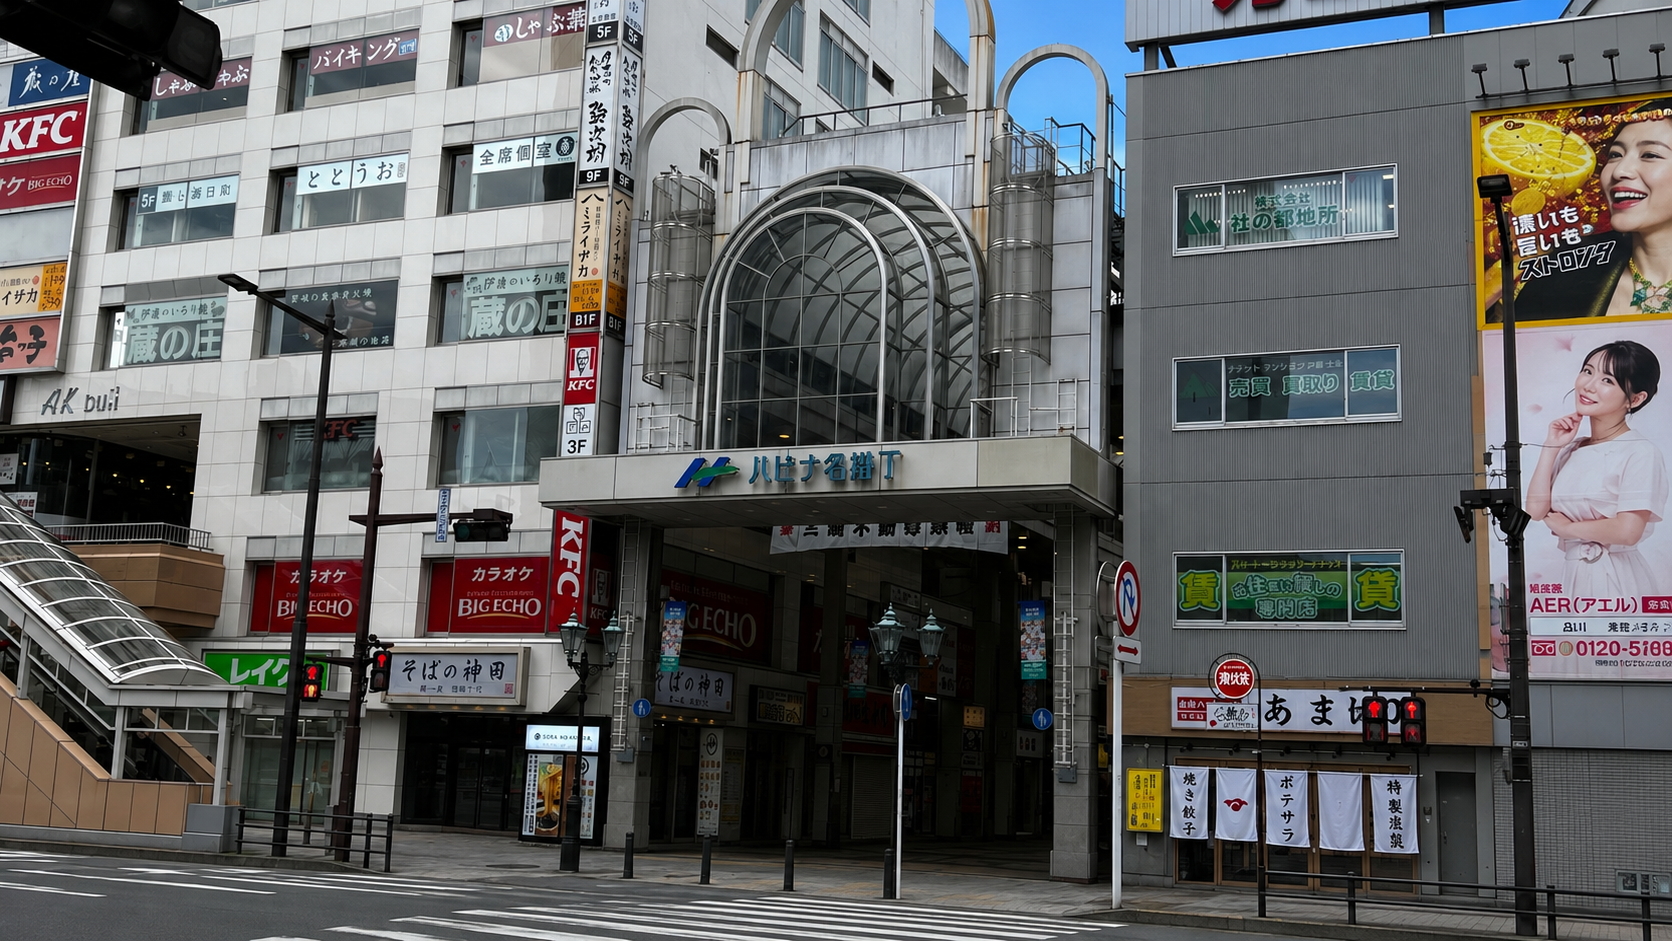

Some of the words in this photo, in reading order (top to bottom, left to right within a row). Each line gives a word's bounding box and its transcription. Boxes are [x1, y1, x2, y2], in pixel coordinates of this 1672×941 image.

[597, 25, 612, 38] 5F
[628, 29, 639, 44] 5F
[313, 37, 401, 69] バイキング
[0, 110, 78, 153] KFC
[479, 141, 552, 166] 全席個室
[27, 178, 45, 191] BIG
[46, 174, 73, 187] ECHO
[308, 161, 394, 188] ととうお
[586, 170, 601, 183] 9F
[618, 174, 630, 187] 9F
[141, 193, 156, 208] 5F
[575, 313, 596, 326] B1F
[608, 316, 622, 331] B1F
[127, 320, 222, 364] 蔵の庄
[567, 379, 595, 392] KFC
[1229, 376, 1271, 398] 売買
[41, 387, 79, 415] AK
[567, 439, 588, 454] 3F
[557, 516, 584, 598] KFC
[471, 566, 534, 582] カラオケ
[308, 598, 353, 618] ECHO
[458, 598, 490, 618] BIG
[493, 597, 542, 617] ECHO
[590, 607, 609, 620] KFC
[702, 605, 757, 648] ECHO
[402, 658, 505, 683] そばの神田
[1182, 772, 1197, 836] 焼き餃子
